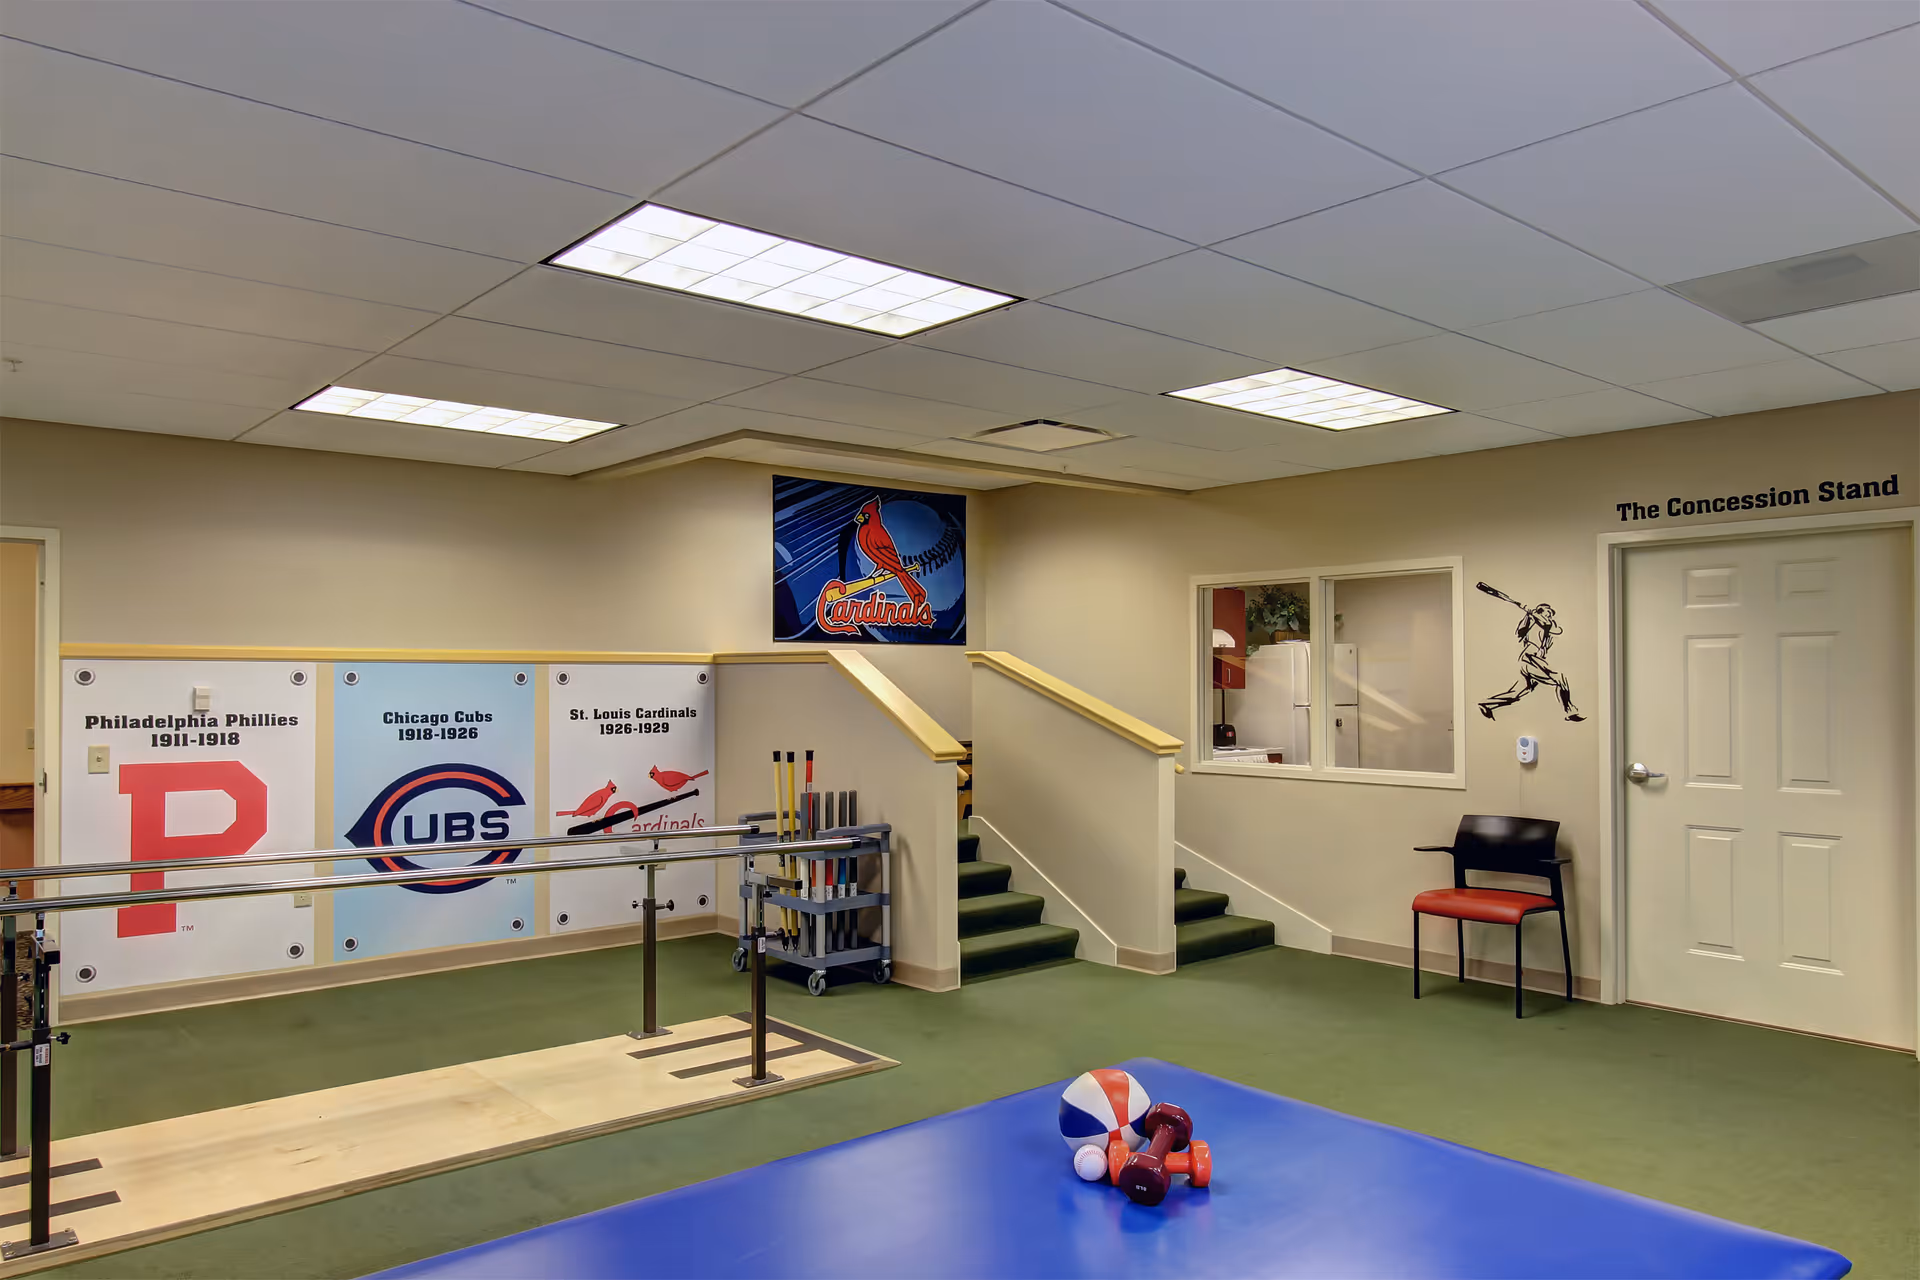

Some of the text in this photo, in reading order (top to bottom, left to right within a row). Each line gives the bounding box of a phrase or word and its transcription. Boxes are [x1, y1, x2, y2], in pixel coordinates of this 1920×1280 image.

[1616, 474, 1899, 521] The Concession Stand
[816, 578, 937, 636] Cardinals
[85, 713, 299, 731] Philadelphia Phillies
[383, 710, 493, 727] Chicago Cubs
[569, 707, 697, 721] St. Louis Cardinals
[398, 726, 479, 741] 1918-1926
[599, 722, 670, 735] 1926-1929
[151, 732, 240, 748] 1911-1918
[117, 761, 267, 938] P
